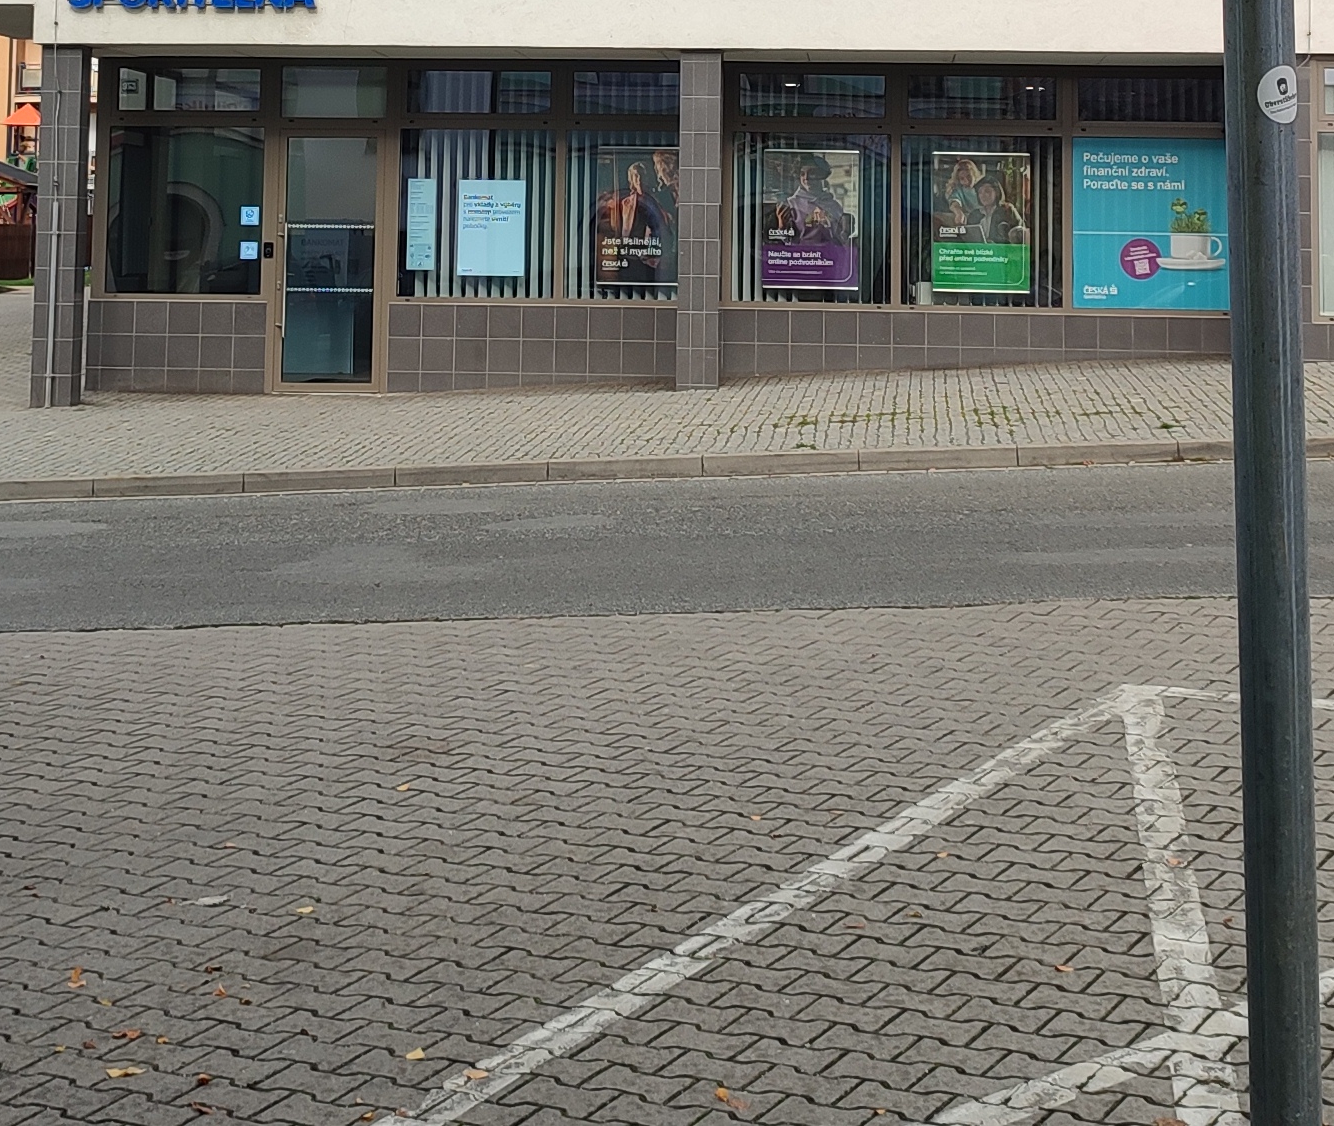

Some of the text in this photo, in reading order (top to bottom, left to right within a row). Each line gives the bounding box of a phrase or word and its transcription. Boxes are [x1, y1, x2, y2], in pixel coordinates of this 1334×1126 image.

[1083, 152, 1138, 165] Pečujeme
[1152, 153, 1179, 164] vaše
[1083, 165, 1169, 177] finanční zdraví.
[1083, 178, 1129, 190] Poraďte
[1131, 181, 1145, 189] se
[1157, 179, 1185, 190] námi
